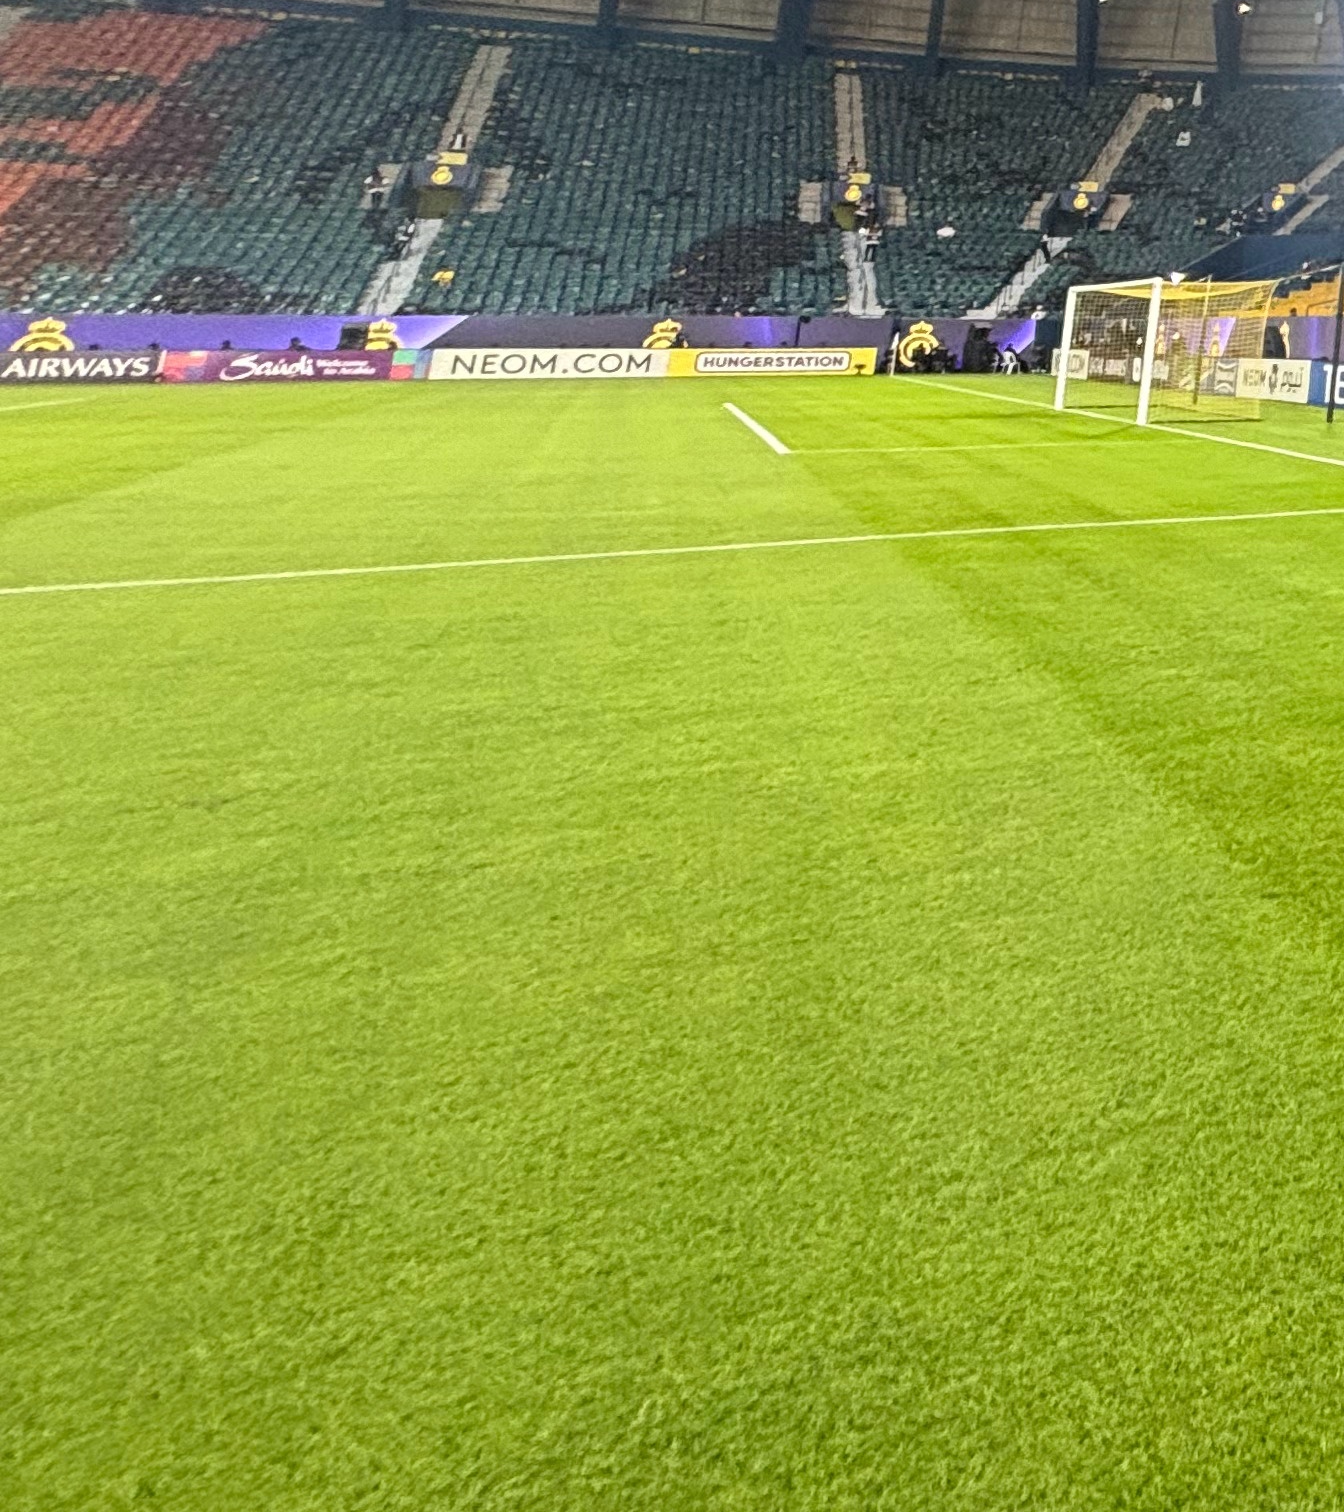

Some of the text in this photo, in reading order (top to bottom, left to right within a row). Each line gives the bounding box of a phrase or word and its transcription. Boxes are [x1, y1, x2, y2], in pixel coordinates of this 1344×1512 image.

[0, 357, 151, 378] AIRWAYS
[219, 354, 314, 381] Saudi
[450, 353, 654, 375] NEOM.COM
[702, 355, 845, 370] HUNGERSTATION
